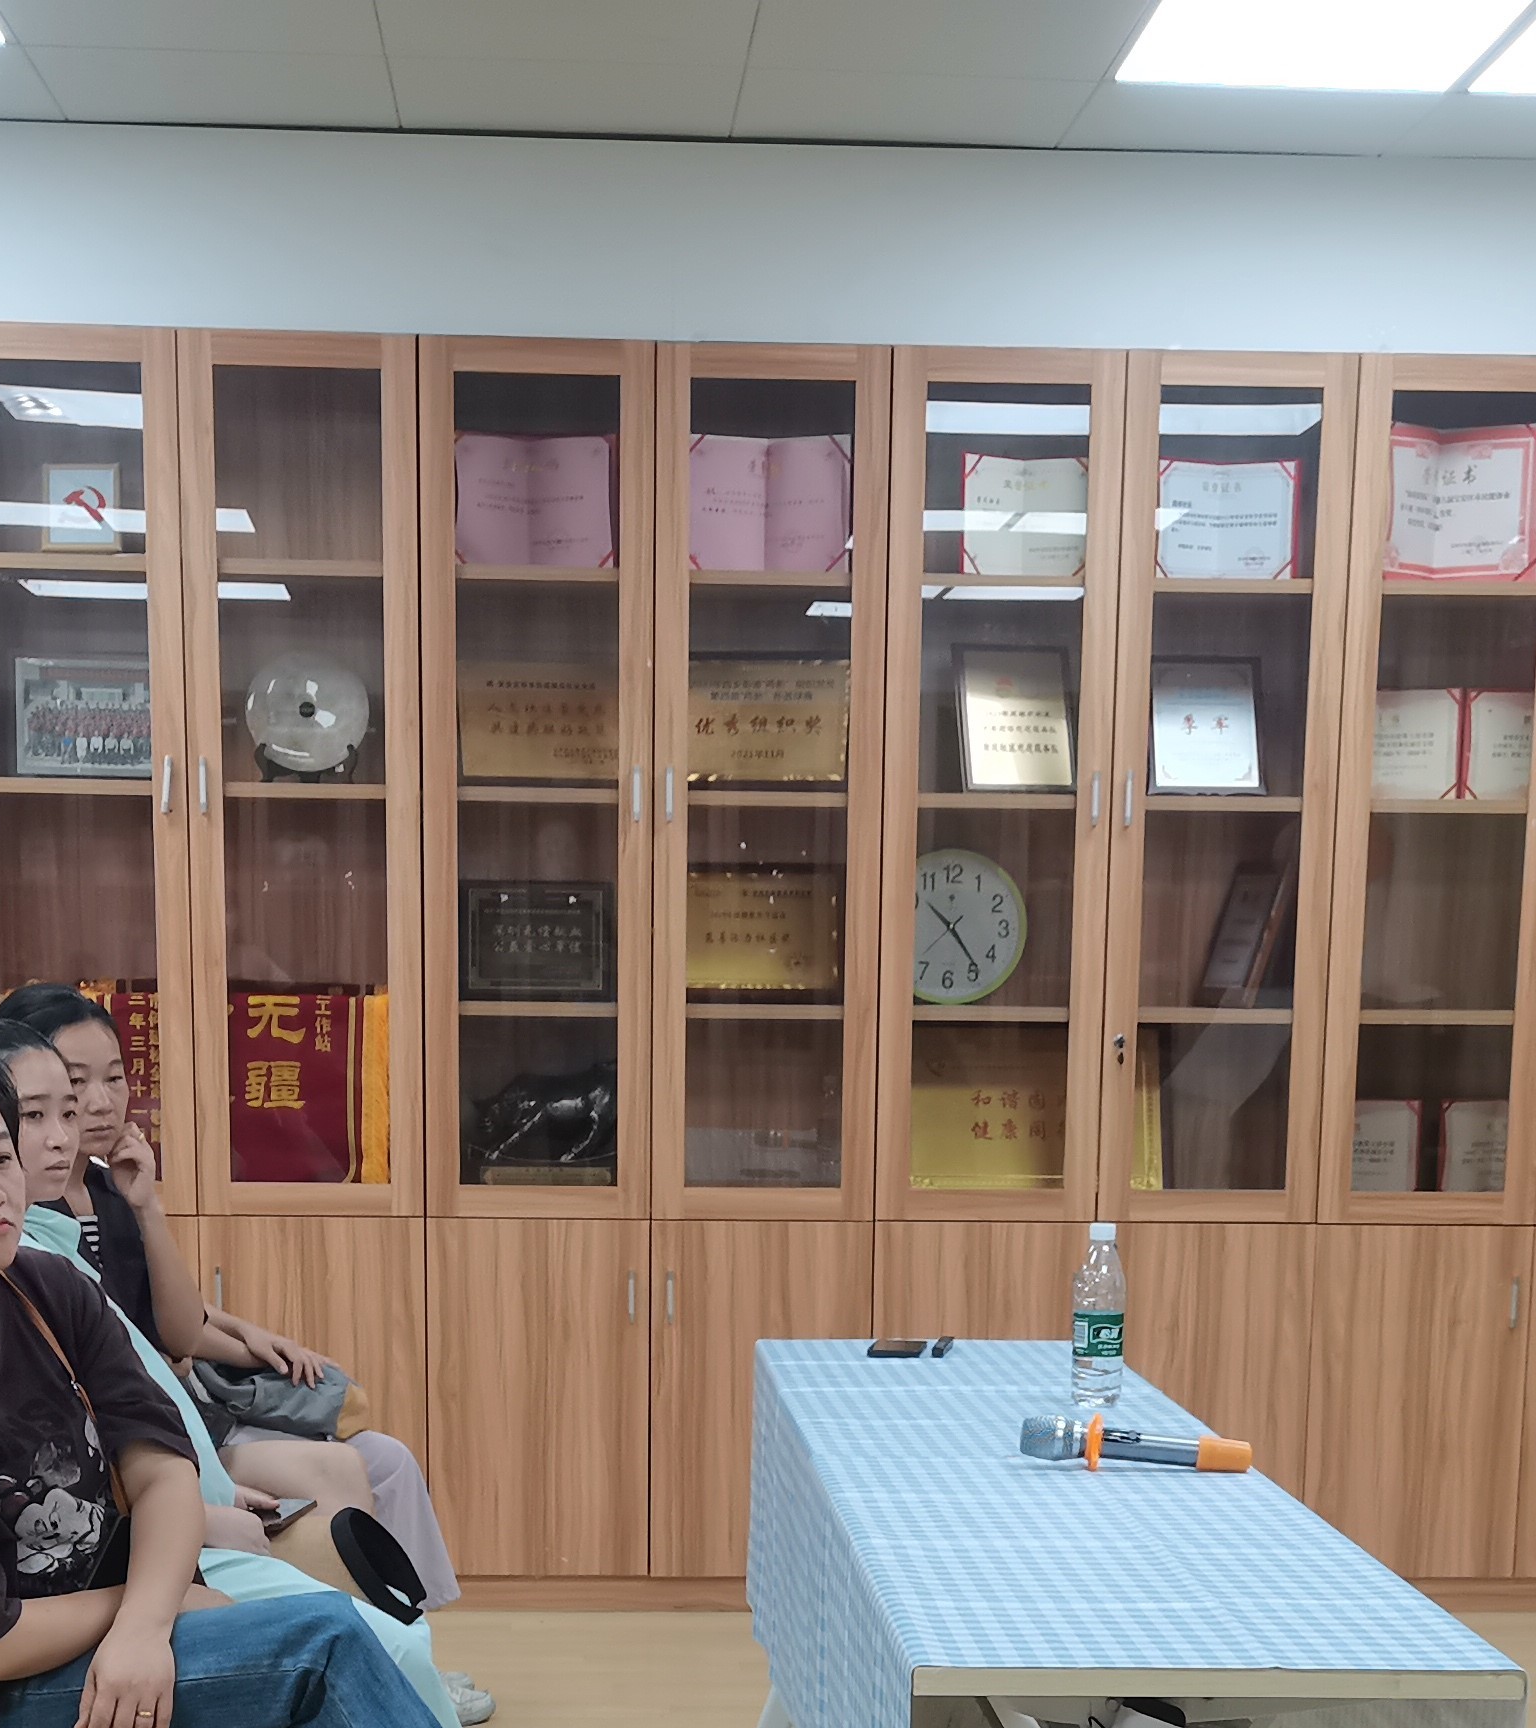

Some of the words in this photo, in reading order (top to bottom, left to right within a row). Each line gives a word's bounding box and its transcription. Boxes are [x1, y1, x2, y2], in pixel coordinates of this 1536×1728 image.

[921, 872, 936, 892] 11
[943, 864, 963, 884] 12
[975, 874, 982, 892] 1
[991, 893, 1004, 913] 2
[998, 919, 1010, 939] 3
[985, 944, 996, 963] 4
[918, 961, 930, 981] 7
[941, 970, 954, 989] 6
[967, 963, 980, 982] 5
[315, 995, 332, 1052] 工作站
[245, 995, 306, 1110] 无疆
[971, 1089, 1066, 1110] 和谐固
